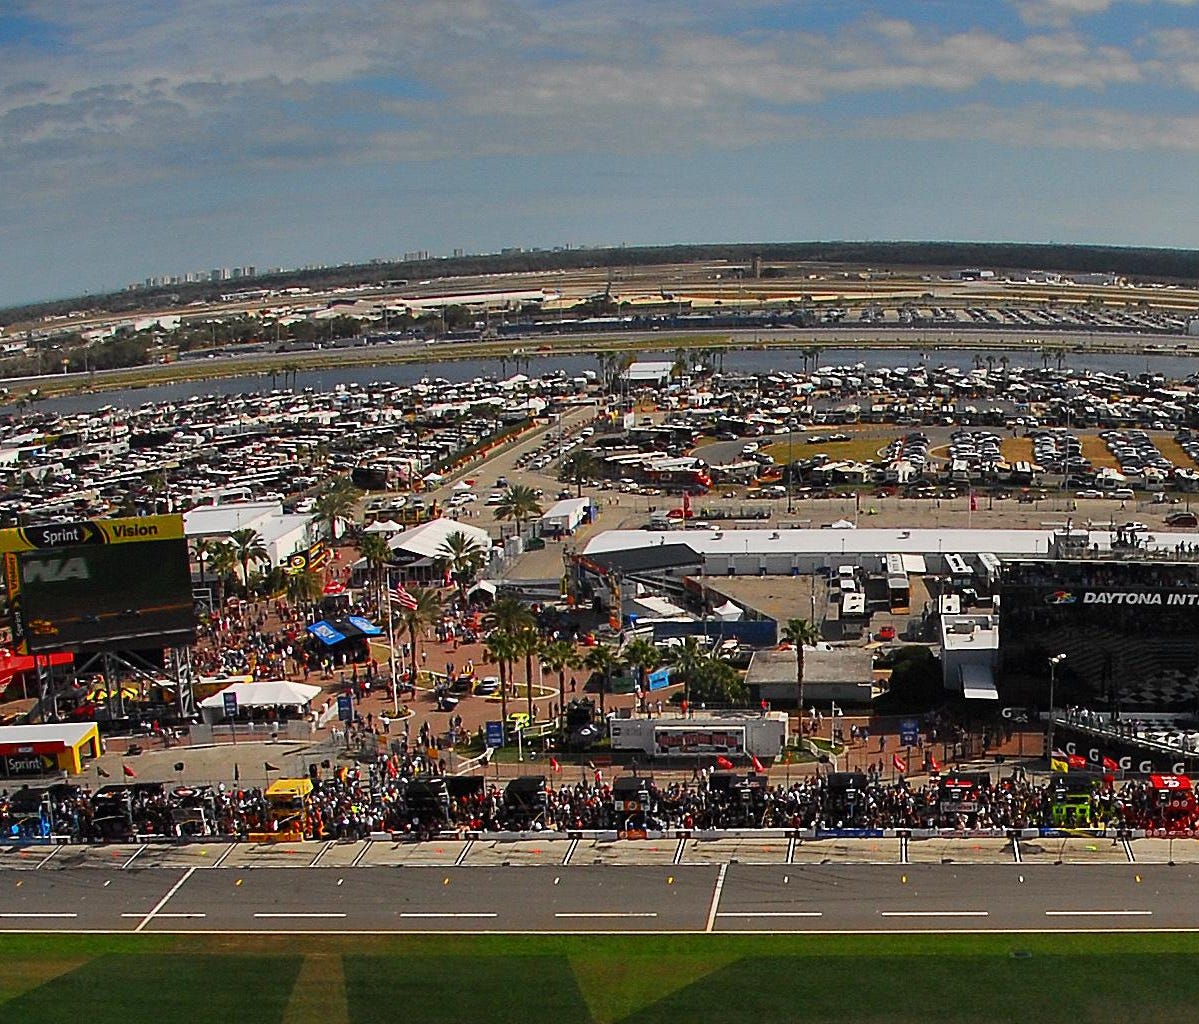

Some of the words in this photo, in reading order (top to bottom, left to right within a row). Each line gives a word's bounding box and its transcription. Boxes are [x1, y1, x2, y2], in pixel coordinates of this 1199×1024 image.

[42, 529, 79, 546] Sprint
[112, 524, 158, 538] Vision
[1083, 592, 1162, 605] DAYTONA
[1002, 708, 1012, 718] G
[1066, 742, 1076, 754] G
[1089, 748, 1099, 761] G
[8, 758, 42, 770] Sprint
[1119, 756, 1131, 769] G
[1139, 760, 1152, 773] G
[1172, 762, 1185, 774] G
